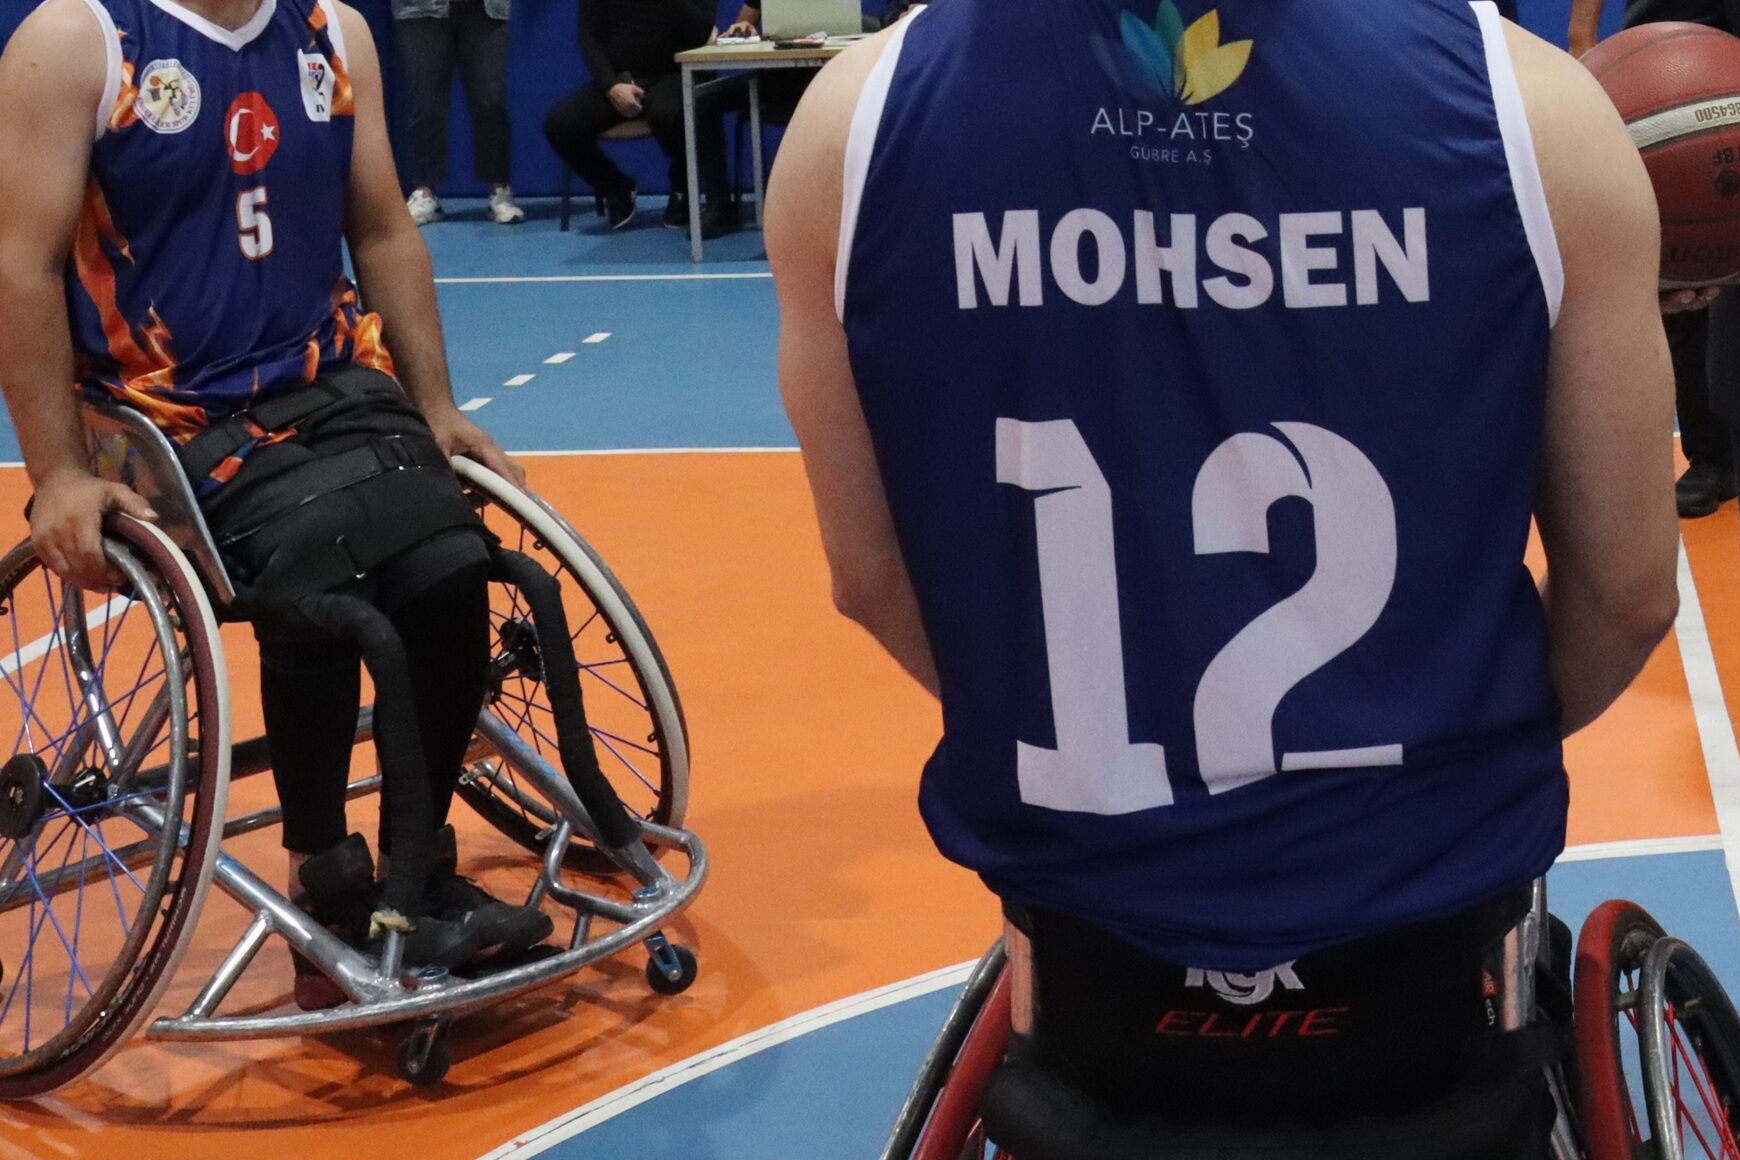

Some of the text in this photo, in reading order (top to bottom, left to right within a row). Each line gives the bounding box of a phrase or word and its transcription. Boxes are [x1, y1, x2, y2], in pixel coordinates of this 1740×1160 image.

[1090, 107, 1254, 149] ALP-ATEŞ
[235, 185, 274, 261] 5
[951, 206, 1431, 310] MOHSEN
[995, 417, 1404, 815] 12
[1155, 1005, 1350, 1038] ELITE
